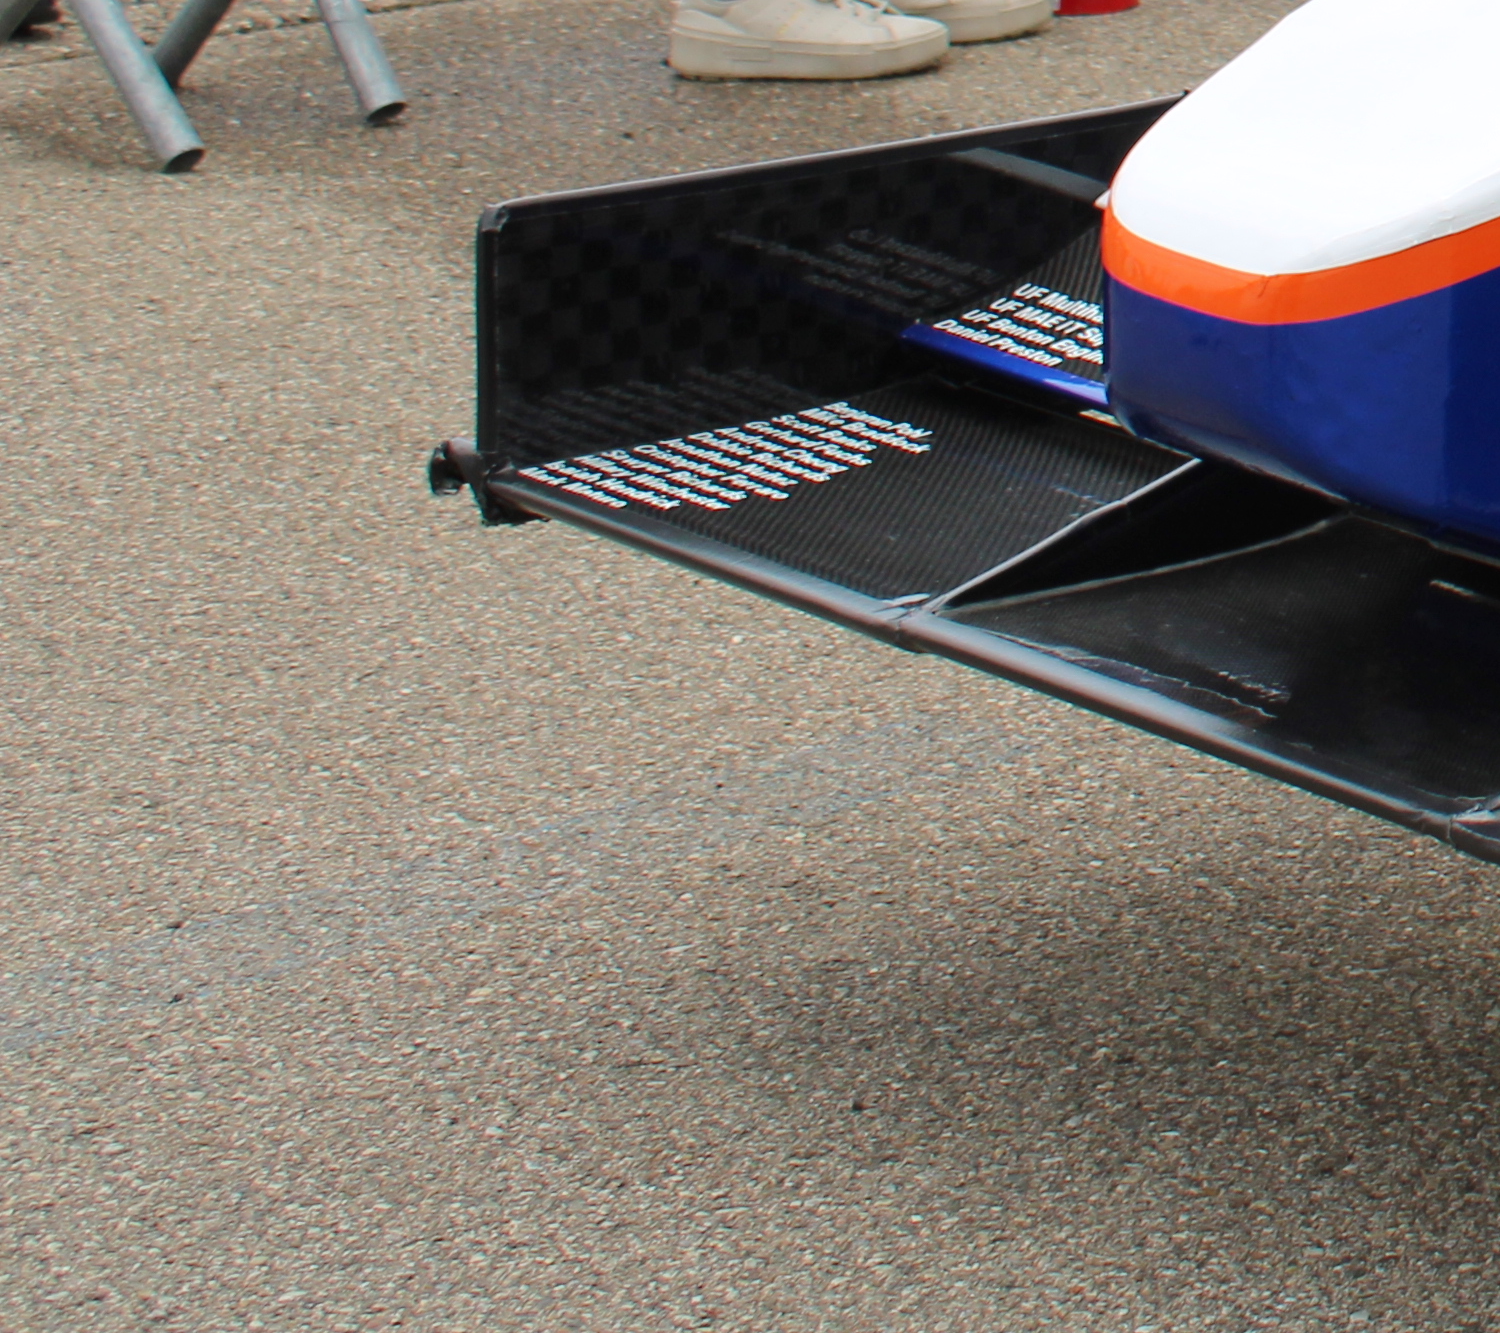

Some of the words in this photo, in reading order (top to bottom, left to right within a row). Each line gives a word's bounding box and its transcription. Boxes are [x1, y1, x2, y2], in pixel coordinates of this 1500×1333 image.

[1013, 283, 1050, 299] UF
[961, 309, 998, 323] UF
[986, 318, 1055, 346] Benton
[989, 297, 1024, 313] UF
[1012, 307, 1067, 329] MAE
[1055, 320, 1087, 336] IT
[932, 319, 1000, 346] Daniel
[988, 337, 1063, 367] Preston
[714, 427, 787, 453] Andrew
[770, 414, 826, 435] Scott
[840, 422, 931, 454] Braddock
[748, 453, 830, 483] Richards
[595, 478, 680, 510] Hendrick
[628, 474, 731, 511] Winchester
[665, 471, 747, 502] Richards
